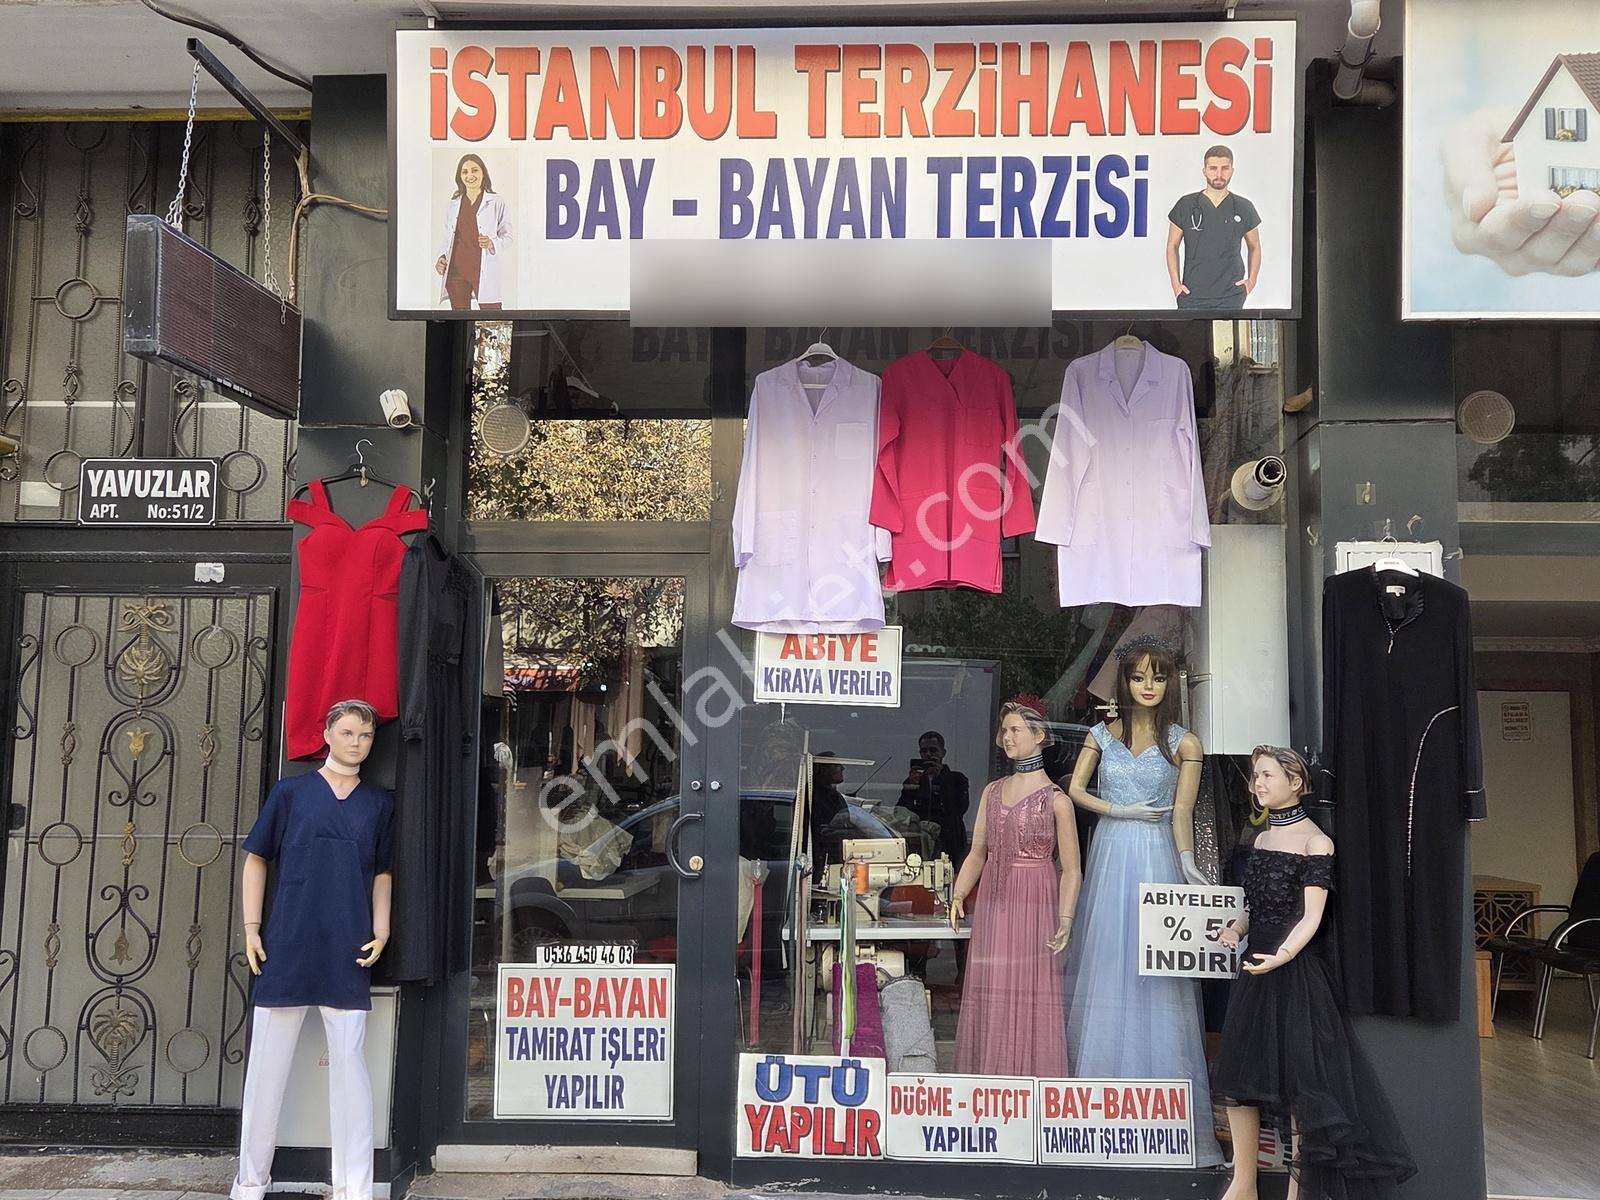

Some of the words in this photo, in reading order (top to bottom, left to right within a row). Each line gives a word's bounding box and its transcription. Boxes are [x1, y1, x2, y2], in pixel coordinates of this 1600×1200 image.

[545, 158, 656, 240] BAY
[672, 199, 699, 217] -
[719, 157, 908, 239] BAYAN
[87, 469, 210, 498] YAVUZLAR
[90, 503, 119, 519] APT.
[147, 504, 205, 519] No:51/2
[1142, 889, 1237, 908] ABİYELER
[1163, 916, 1193, 941] %
[1204, 918, 1238, 942] 5
[544, 945, 573, 963] 0536
[575, 945, 598, 963] 450
[600, 945, 615, 963] 46
[619, 946, 633, 964] 03
[506, 976, 668, 1019] BAY-BAYAN
[544, 1074, 625, 1109] YAPILIR
[755, 1055, 870, 1107] ÜTÜ
[890, 1078, 953, 1117] DÜĞME
[958, 1101, 967, 1109] -
[972, 1087, 1031, 1125] ÇITÇIT
[1044, 1086, 1187, 1120] BAY-BAYAN
[744, 1103, 882, 1156] YAPILIR
[922, 1125, 998, 1153] YAPILIR
[1141, 1128, 1190, 1155] YAPILIR
